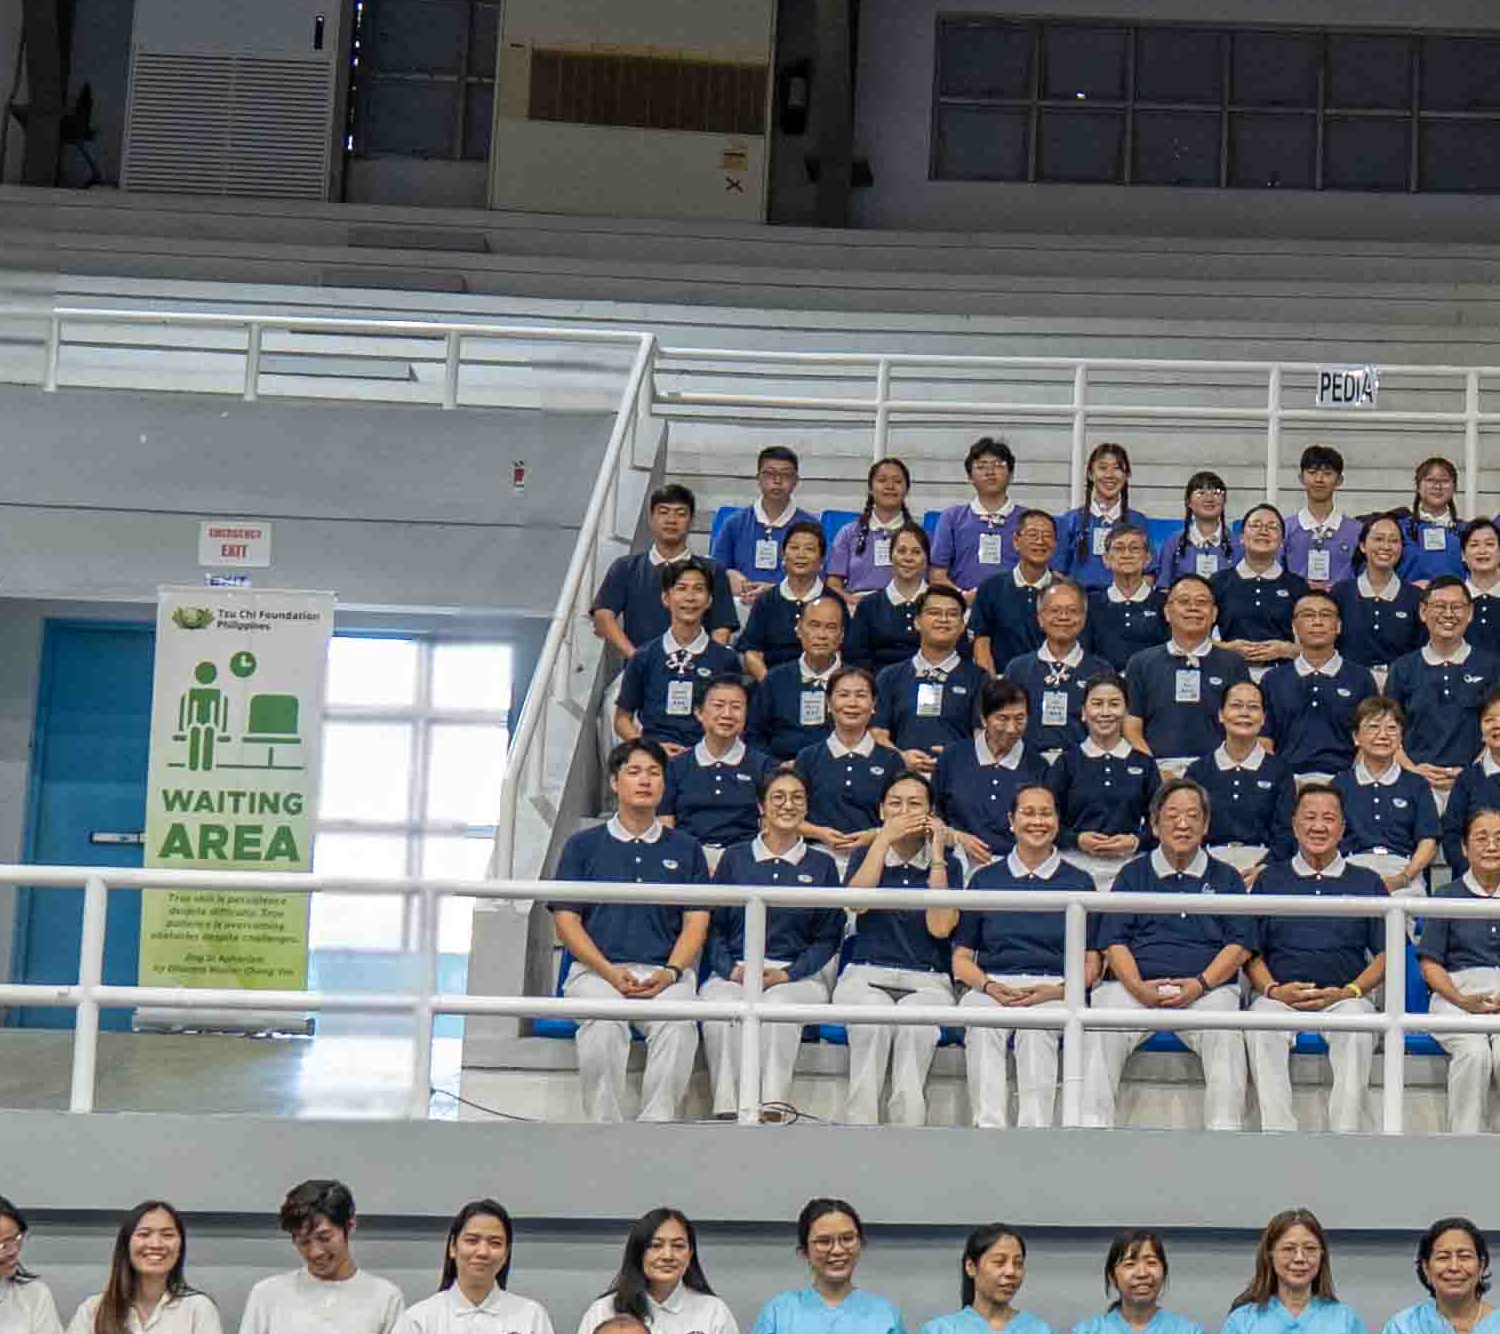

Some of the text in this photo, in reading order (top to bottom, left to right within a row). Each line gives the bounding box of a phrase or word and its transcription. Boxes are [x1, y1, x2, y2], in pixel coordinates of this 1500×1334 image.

[1320, 371, 1374, 403] PEDIA
[221, 544, 247, 559] EXIT
[161, 788, 303, 816] WAITING
[157, 822, 301, 862] AREA
